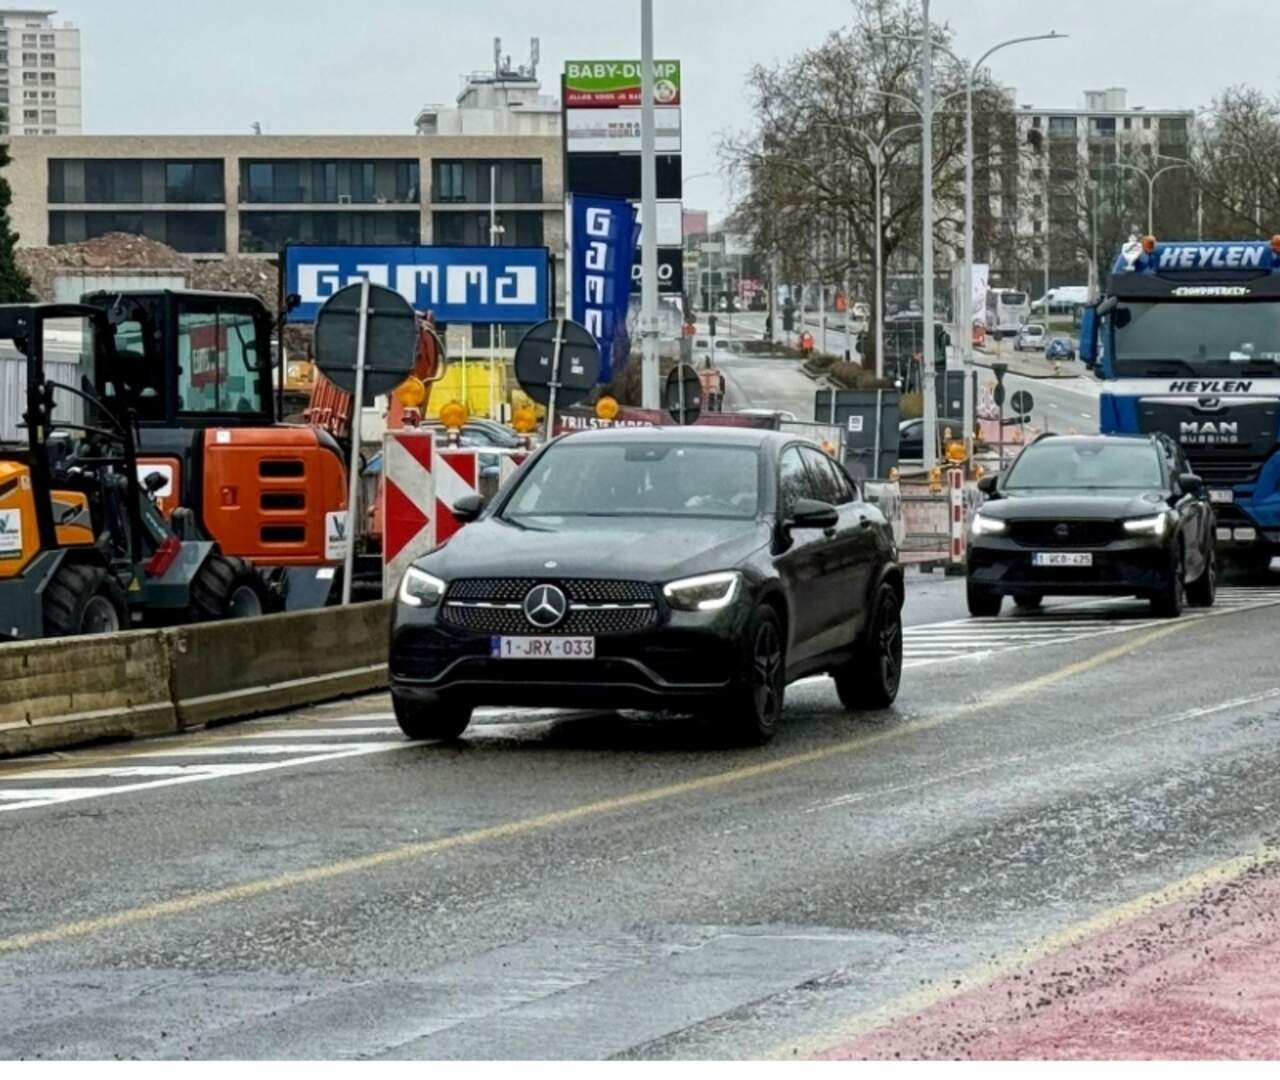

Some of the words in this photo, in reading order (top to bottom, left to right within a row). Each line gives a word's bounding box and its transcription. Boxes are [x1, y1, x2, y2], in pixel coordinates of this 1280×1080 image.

[1158, 246, 1265, 267] HEYLEN
[585, 207, 612, 338] GAMM
[1169, 381, 1252, 393] HEYLEN
[1179, 421, 1238, 434] MAN
[505, 639, 593, 655] 1-JRX-033
